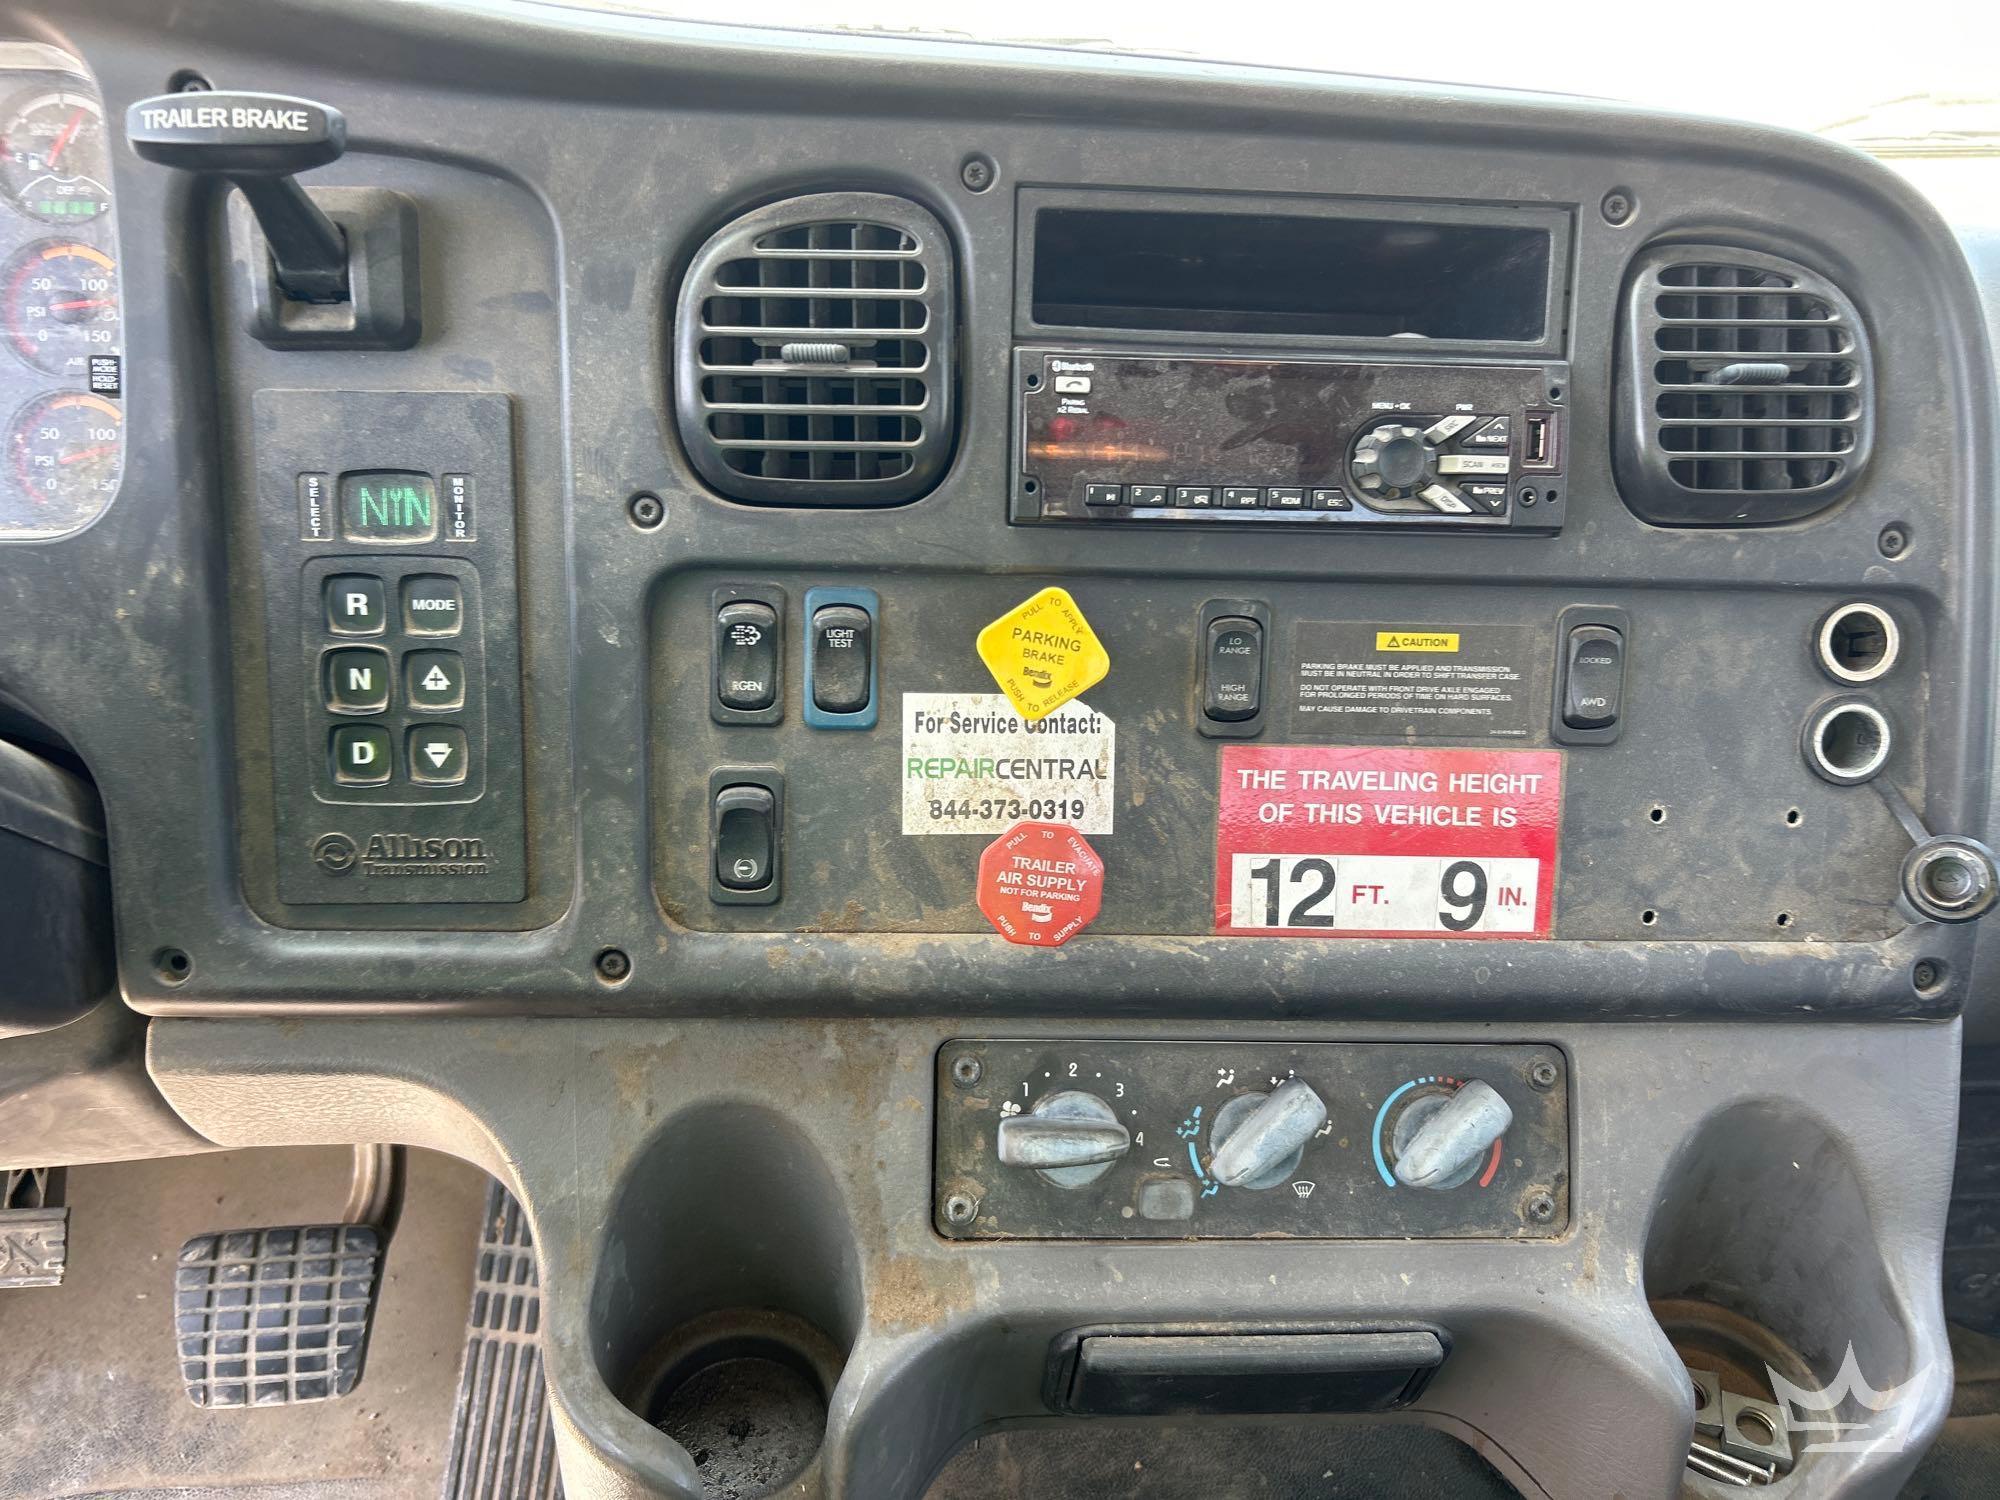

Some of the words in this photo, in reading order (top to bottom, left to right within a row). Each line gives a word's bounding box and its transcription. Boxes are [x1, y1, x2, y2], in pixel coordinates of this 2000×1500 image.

[140, 108, 229, 129] TRAILER
[232, 108, 309, 132] BRAKE
[31, 278, 51, 290] 50
[81, 278, 108, 291] 100
[26, 306, 46, 317] PSI
[37, 330, 48, 342] 0
[84, 330, 111, 342] 150
[40, 427, 60, 440] 50
[87, 428, 116, 440] 100
[35, 455, 55, 467] PSI
[46, 478, 57, 490] 0
[1228, 491, 1235, 499] 4
[1271, 491, 1279, 499] 5
[308, 477, 321, 537] SELECT
[452, 477, 466, 538] MONITOR
[347, 593, 368, 615] R
[412, 599, 456, 611] MODE
[1022, 604, 1044, 620] PULL
[1050, 597, 1062, 607] TO
[1061, 609, 1084, 635] APPLY
[826, 629, 855, 638] LIGHT
[1012, 628, 1082, 652] PARKING
[1229, 637, 1242, 645] LO
[829, 639, 853, 648] TEST
[1402, 637, 1448, 647] CAUTION
[1022, 648, 1065, 665] BRAKE
[1219, 646, 1250, 655] RANGE
[350, 668, 372, 690] N
[1023, 667, 1052, 680] Bendix
[732, 681, 762, 691] RGEN
[1221, 684, 1245, 692] HIGH
[1007, 678, 1025, 703] PUSH
[1027, 703, 1040, 712] TO
[1043, 680, 1079, 707] RELEASE
[1218, 693, 1249, 701] RANGE
[1580, 697, 1607, 707] AWD
[915, 711, 944, 734] For
[950, 711, 1018, 734] Service
[1024, 713, 1101, 735] Contact:
[352, 741, 375, 764] D
[907, 757, 1107, 780] REPAIRCENTRAL
[1237, 769, 1287, 790] THE
[1298, 770, 1438, 793] TRAVELING
[1449, 773, 1542, 794] HEIGHT
[929, 799, 1084, 820] 844-373-0319
[1258, 803, 1295, 823] OF
[1304, 803, 1362, 825] THIS
[1374, 804, 1482, 827] VEHICLE
[1493, 807, 1518, 828] IS
[362, 833, 487, 858] Allison
[1006, 832, 1028, 849] PULL
[1041, 830, 1054, 839] TO
[1067, 836, 1100, 877] EVACUATE
[362, 861, 489, 875] Transmission
[1012, 856, 1076, 875] TRAILER
[996, 871, 1022, 886] AIR
[1026, 874, 1087, 892] SUPPLY
[1000, 886, 1019, 895] NOT
[1020, 889, 1039, 898] FOR
[1040, 891, 1080, 902] PARKING
[1251, 858, 1336, 928] 12
[1352, 885, 1389, 905] FT.
[1438, 860, 1488, 932] 9
[1498, 887, 1527, 906] IN.
[1021, 901, 1053, 914] Bendix
[997, 915, 1017, 937] PUSH
[1028, 932, 1041, 940] TO
[1053, 915, 1083, 942] SUPPLY
[1068, 1062, 1078, 1077] 2
[1022, 1081, 1029, 1097] 1
[1115, 1082, 1124, 1097] 3
[1135, 1131, 1144, 1146] 4
